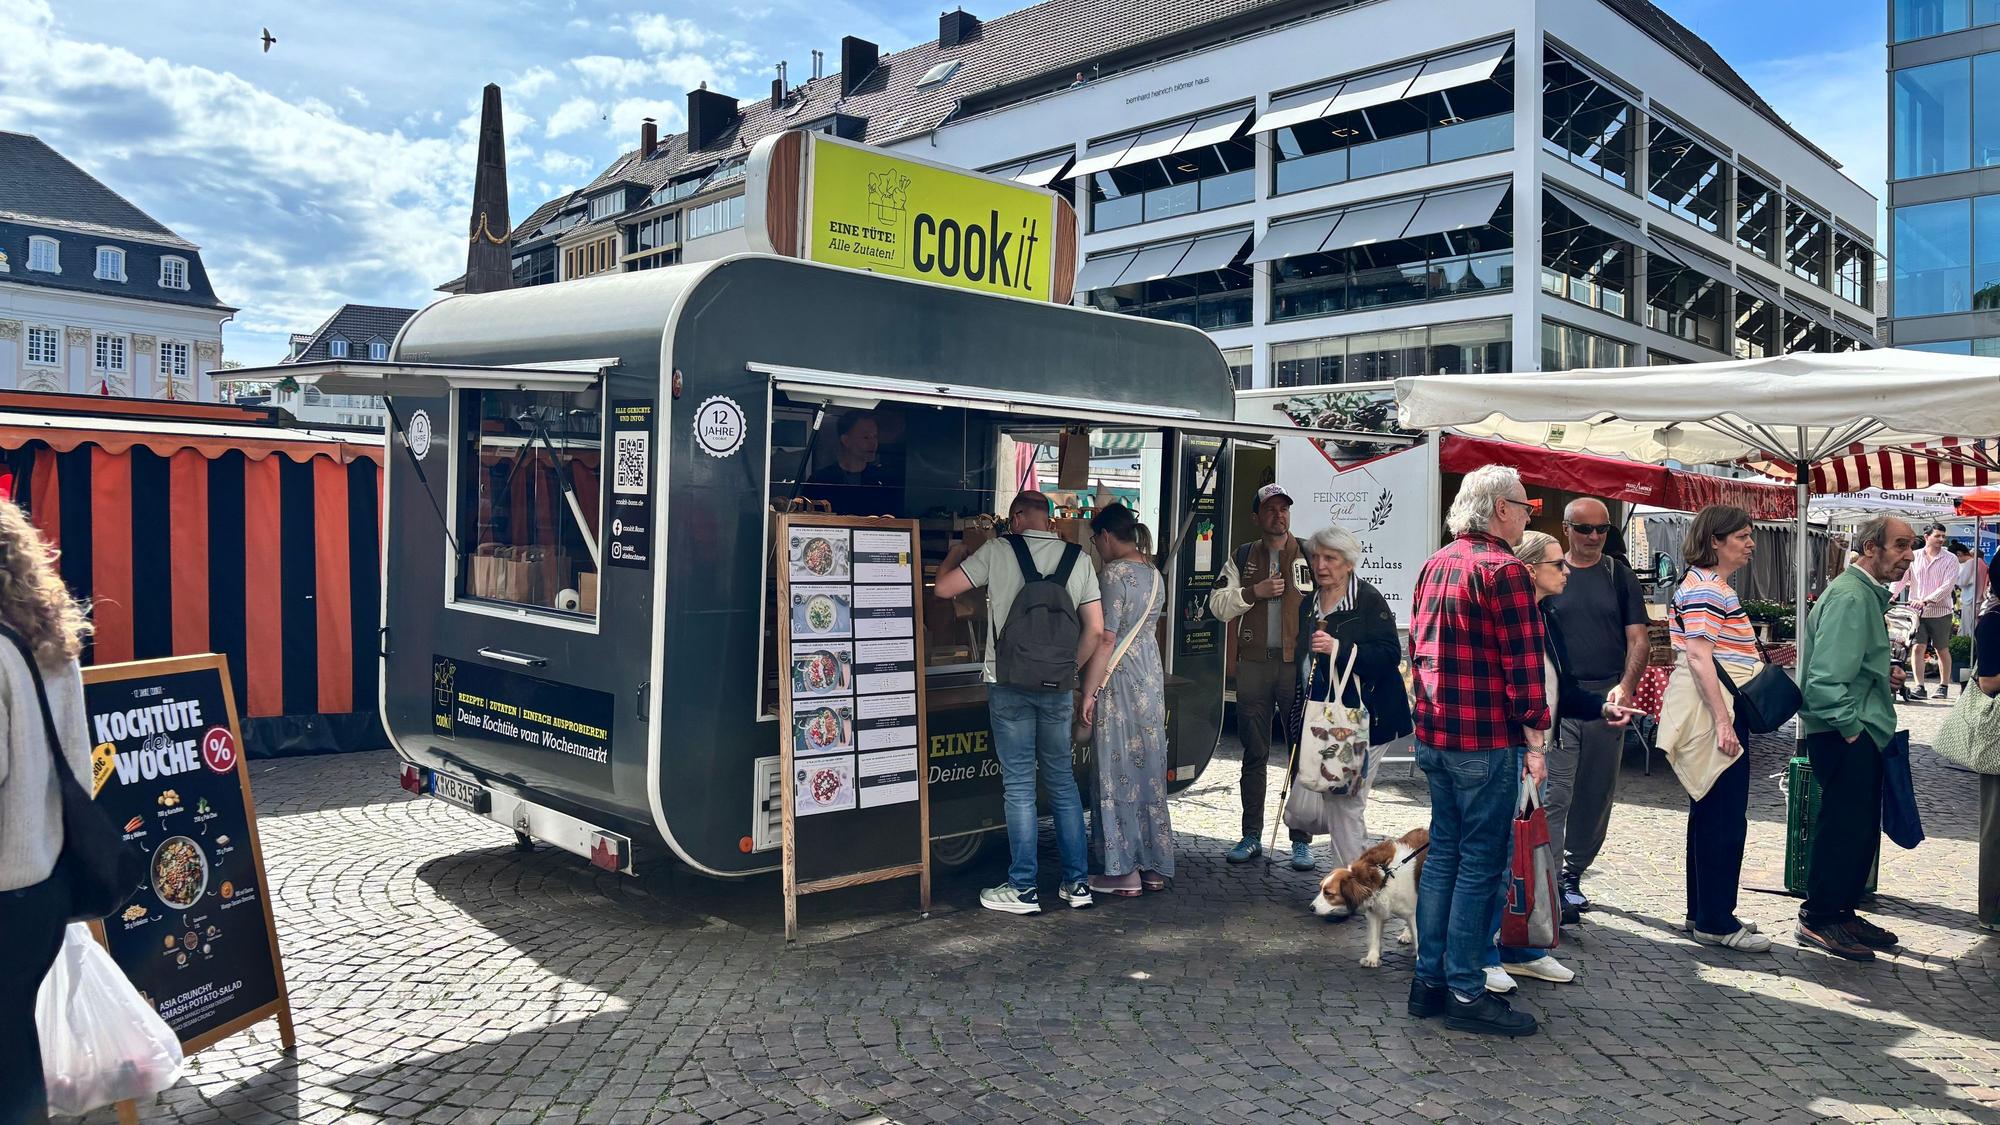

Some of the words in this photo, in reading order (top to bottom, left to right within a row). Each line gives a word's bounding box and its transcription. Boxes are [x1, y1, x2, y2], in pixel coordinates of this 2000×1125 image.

[1151, 86, 1173, 98] heinrich
[1194, 76, 1210, 85] haus
[829, 221, 859, 237] EINE
[861, 226, 896, 244] TÜTE!
[828, 237, 850, 252] Alle
[853, 242, 895, 260] Zutaten!
[912, 209, 1038, 291] cookit
[416, 421, 424, 433] 12
[712, 410, 728, 425] 12
[705, 426, 735, 437] JAHRE
[1313, 491, 1369, 503] FEINKOST
[1880, 491, 1914, 502] GmbH
[1360, 556, 1403, 570] Anlass
[1362, 573, 1384, 585] wir
[94, 698, 204, 743] KOCHTÜTE
[458, 692, 485, 708] REZEPTE
[489, 700, 518, 716] ZUTATEN
[523, 709, 552, 725] EINFACH
[552, 717, 608, 740] AUSPROBIEREN!
[143, 732, 174, 752] der
[457, 707, 481, 727] Deine
[482, 714, 519, 738] Kochtüte
[520, 728, 540, 744] vom
[542, 730, 608, 764] Wochenmarkt
[929, 730, 989, 759] EINE
[113, 739, 201, 786] WOCHE
[927, 763, 976, 785] Deine
[444, 777, 457, 798] KB
[160, 997, 177, 1012] ASIA
[177, 982, 213, 1004] CRUNCHY
